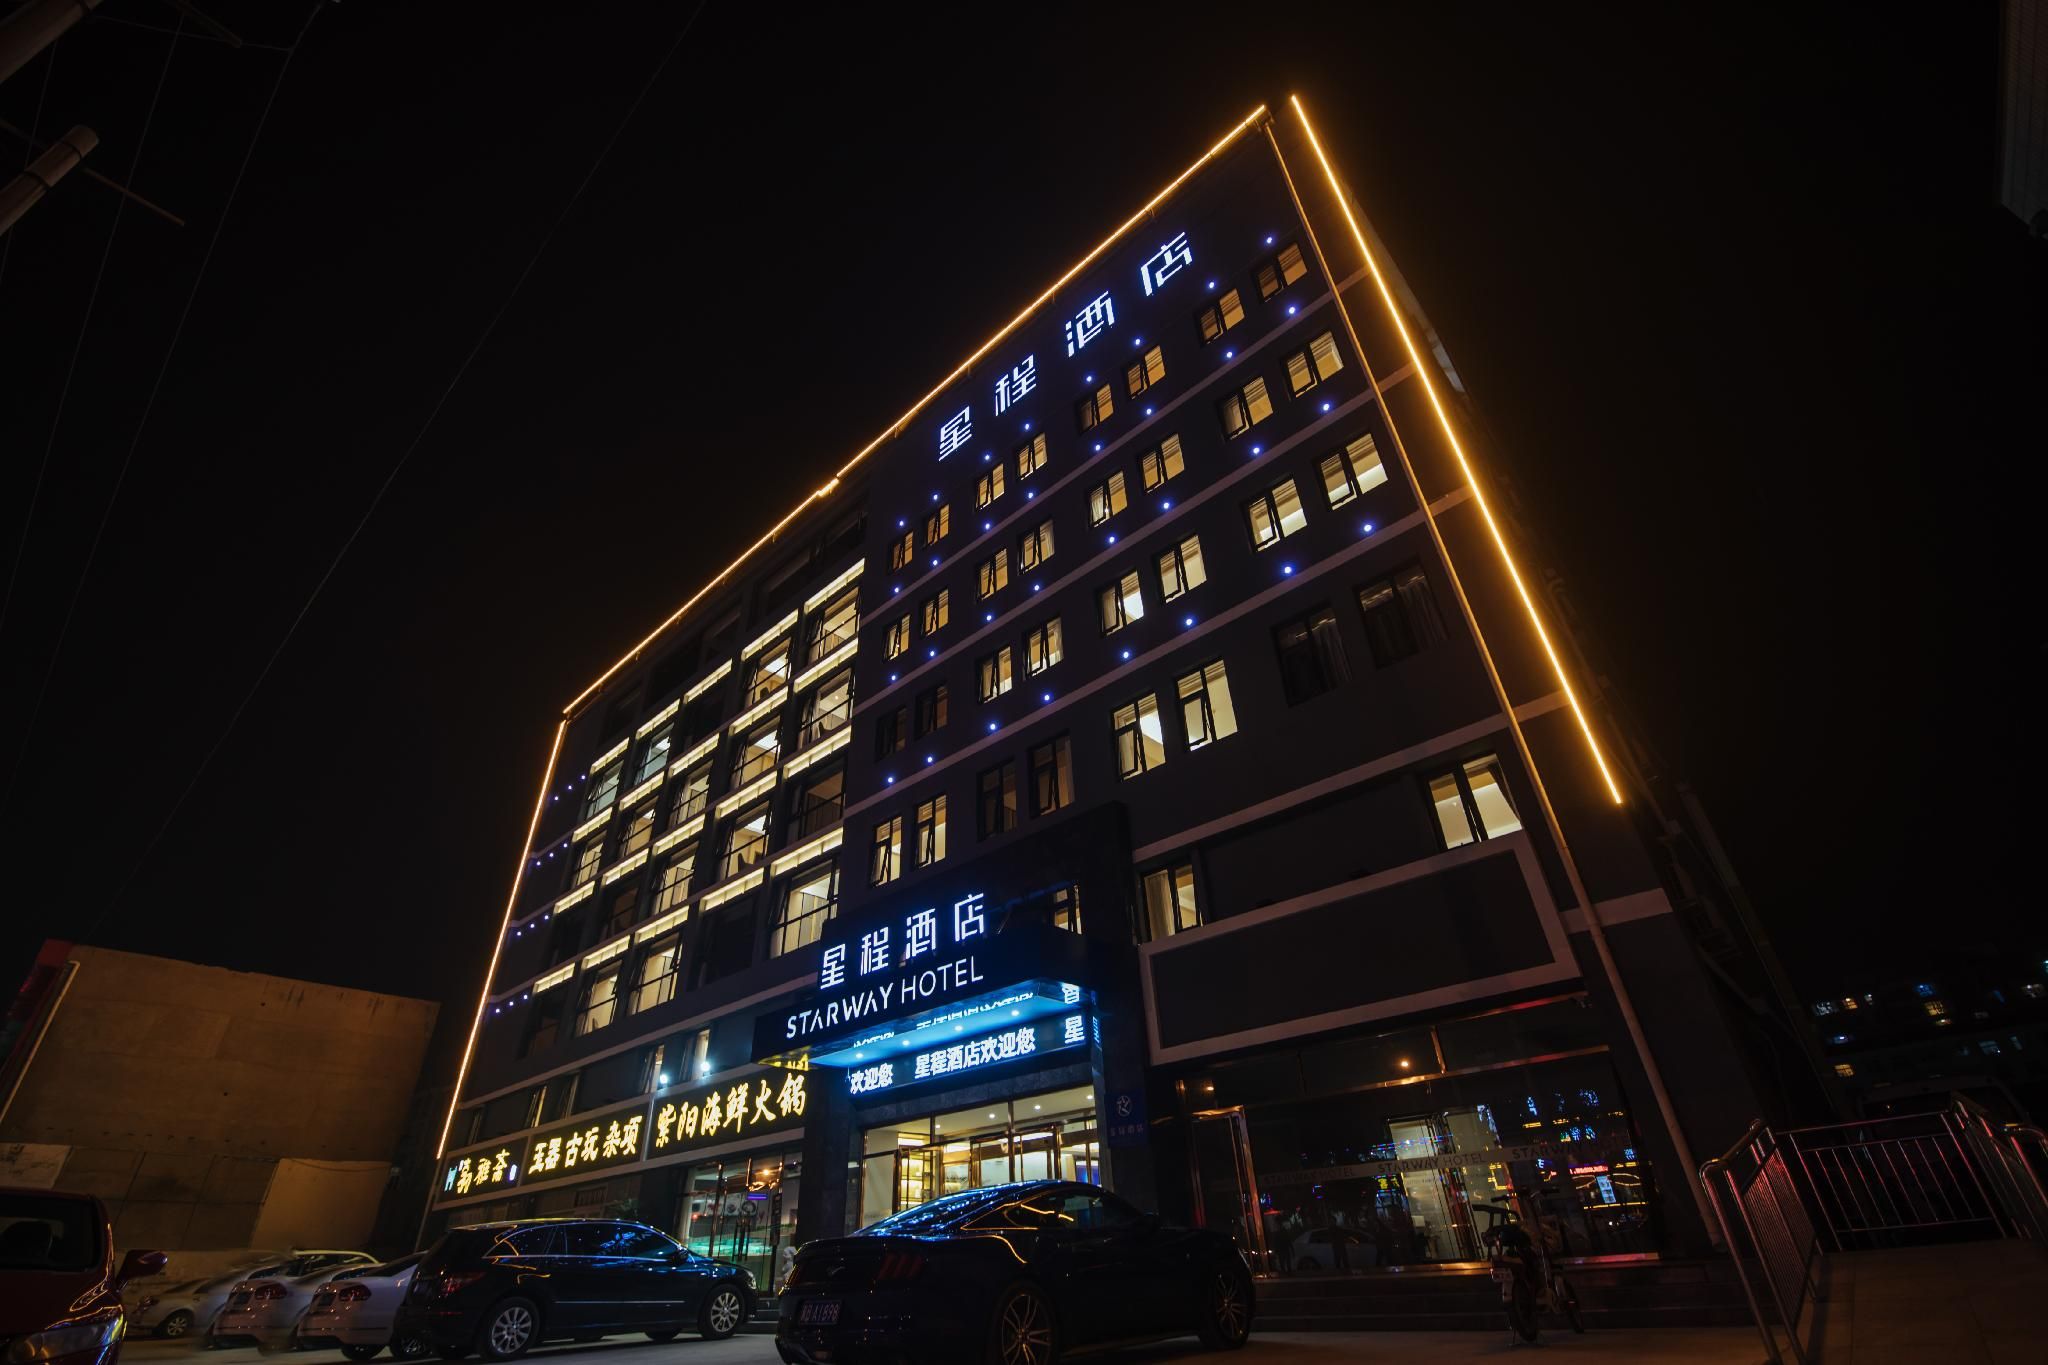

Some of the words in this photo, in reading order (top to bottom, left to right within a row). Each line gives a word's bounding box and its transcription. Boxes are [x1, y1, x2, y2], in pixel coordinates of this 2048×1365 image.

[938, 231, 1193, 462] 星程酒店
[820, 892, 985, 990] 星程酒店
[786, 982, 894, 1039] STARWAY
[901, 955, 984, 1004] HOTEL
[850, 1062, 894, 1095] 欢迎您
[914, 1026, 1036, 1080] 星程酒店欢迎您
[1064, 1015, 1085, 1044] 星
[1377, 1158, 1439, 1174] STARWAY
[1443, 1153, 1486, 1167] HOTEL
